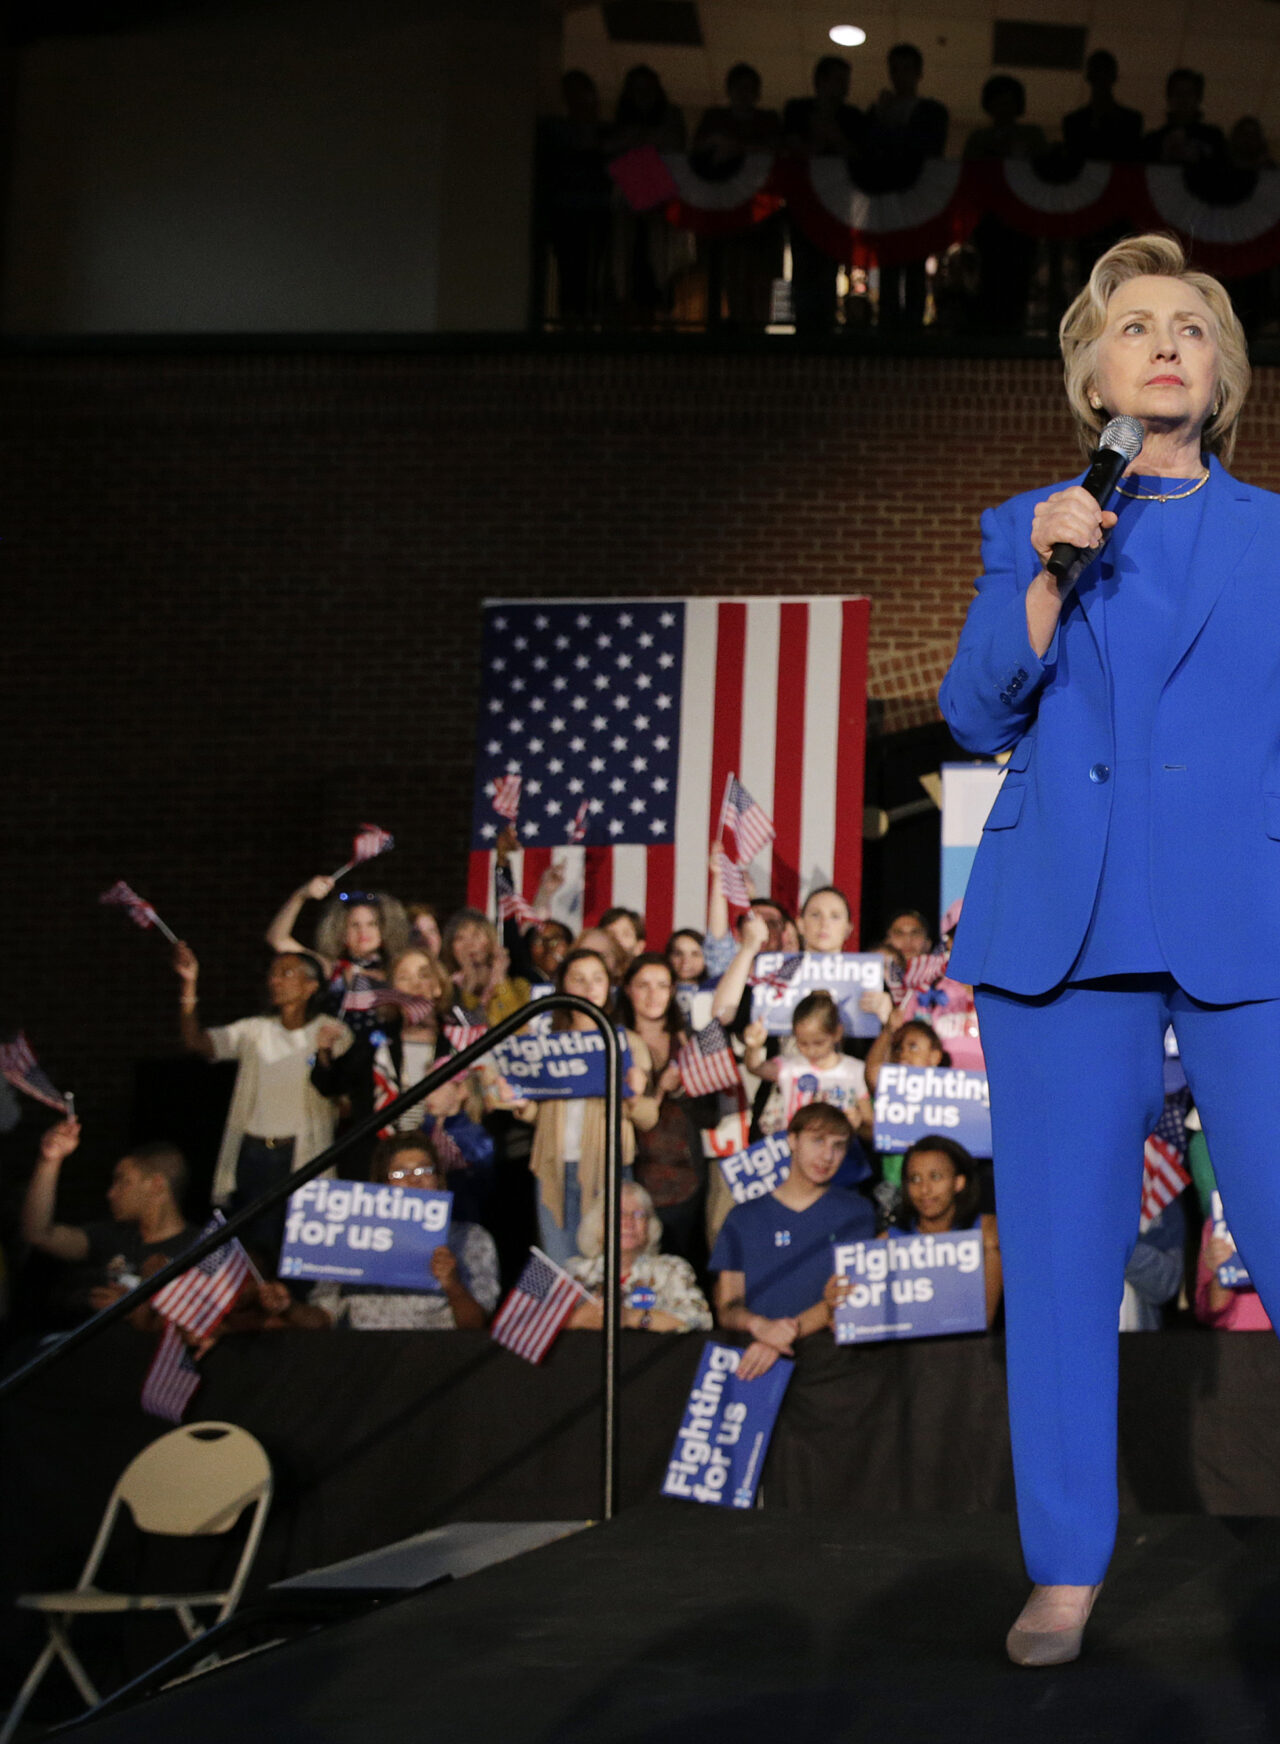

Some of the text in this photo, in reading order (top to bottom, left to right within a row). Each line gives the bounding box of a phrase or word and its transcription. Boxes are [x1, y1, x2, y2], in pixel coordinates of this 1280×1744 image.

[755, 952, 882, 989] Fihting
[547, 1058, 588, 1078] us
[874, 1097, 960, 1128] for us
[721, 1135, 791, 1184] Figh
[290, 1180, 449, 1232] Fighting
[286, 1211, 393, 1252] for us
[835, 1236, 981, 1281] Fighting
[891, 1277, 934, 1304] us
[664, 1346, 741, 1496] Fighting
[693, 1402, 747, 1502] for us
